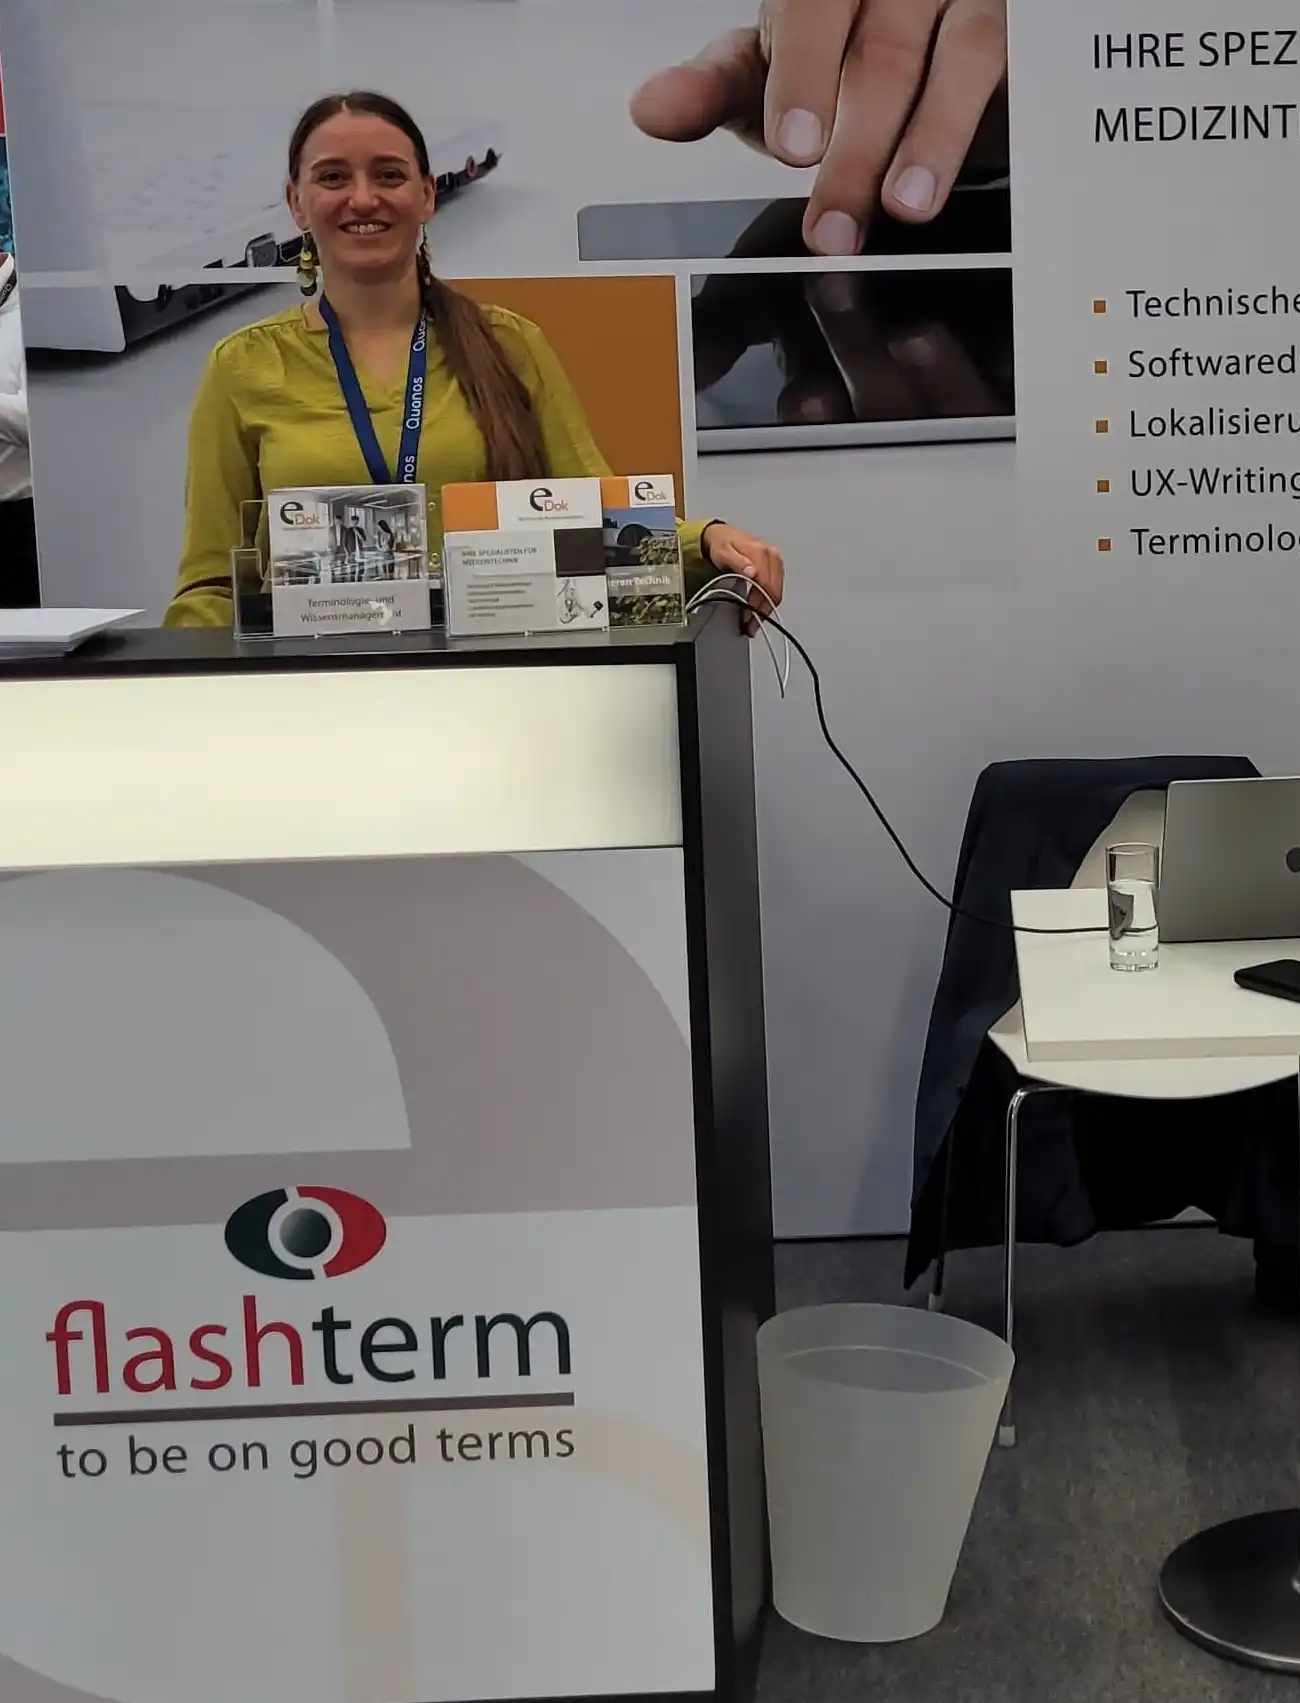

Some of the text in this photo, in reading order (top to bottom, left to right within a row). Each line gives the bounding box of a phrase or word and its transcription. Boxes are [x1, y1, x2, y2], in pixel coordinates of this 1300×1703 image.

[1095, 33, 1184, 68] IHRE
[406, 376, 424, 430] Quanos
[403, 455, 415, 483] nos
[46, 1295, 574, 1395] flashterm
[57, 1424, 574, 1479] to be on good terms
